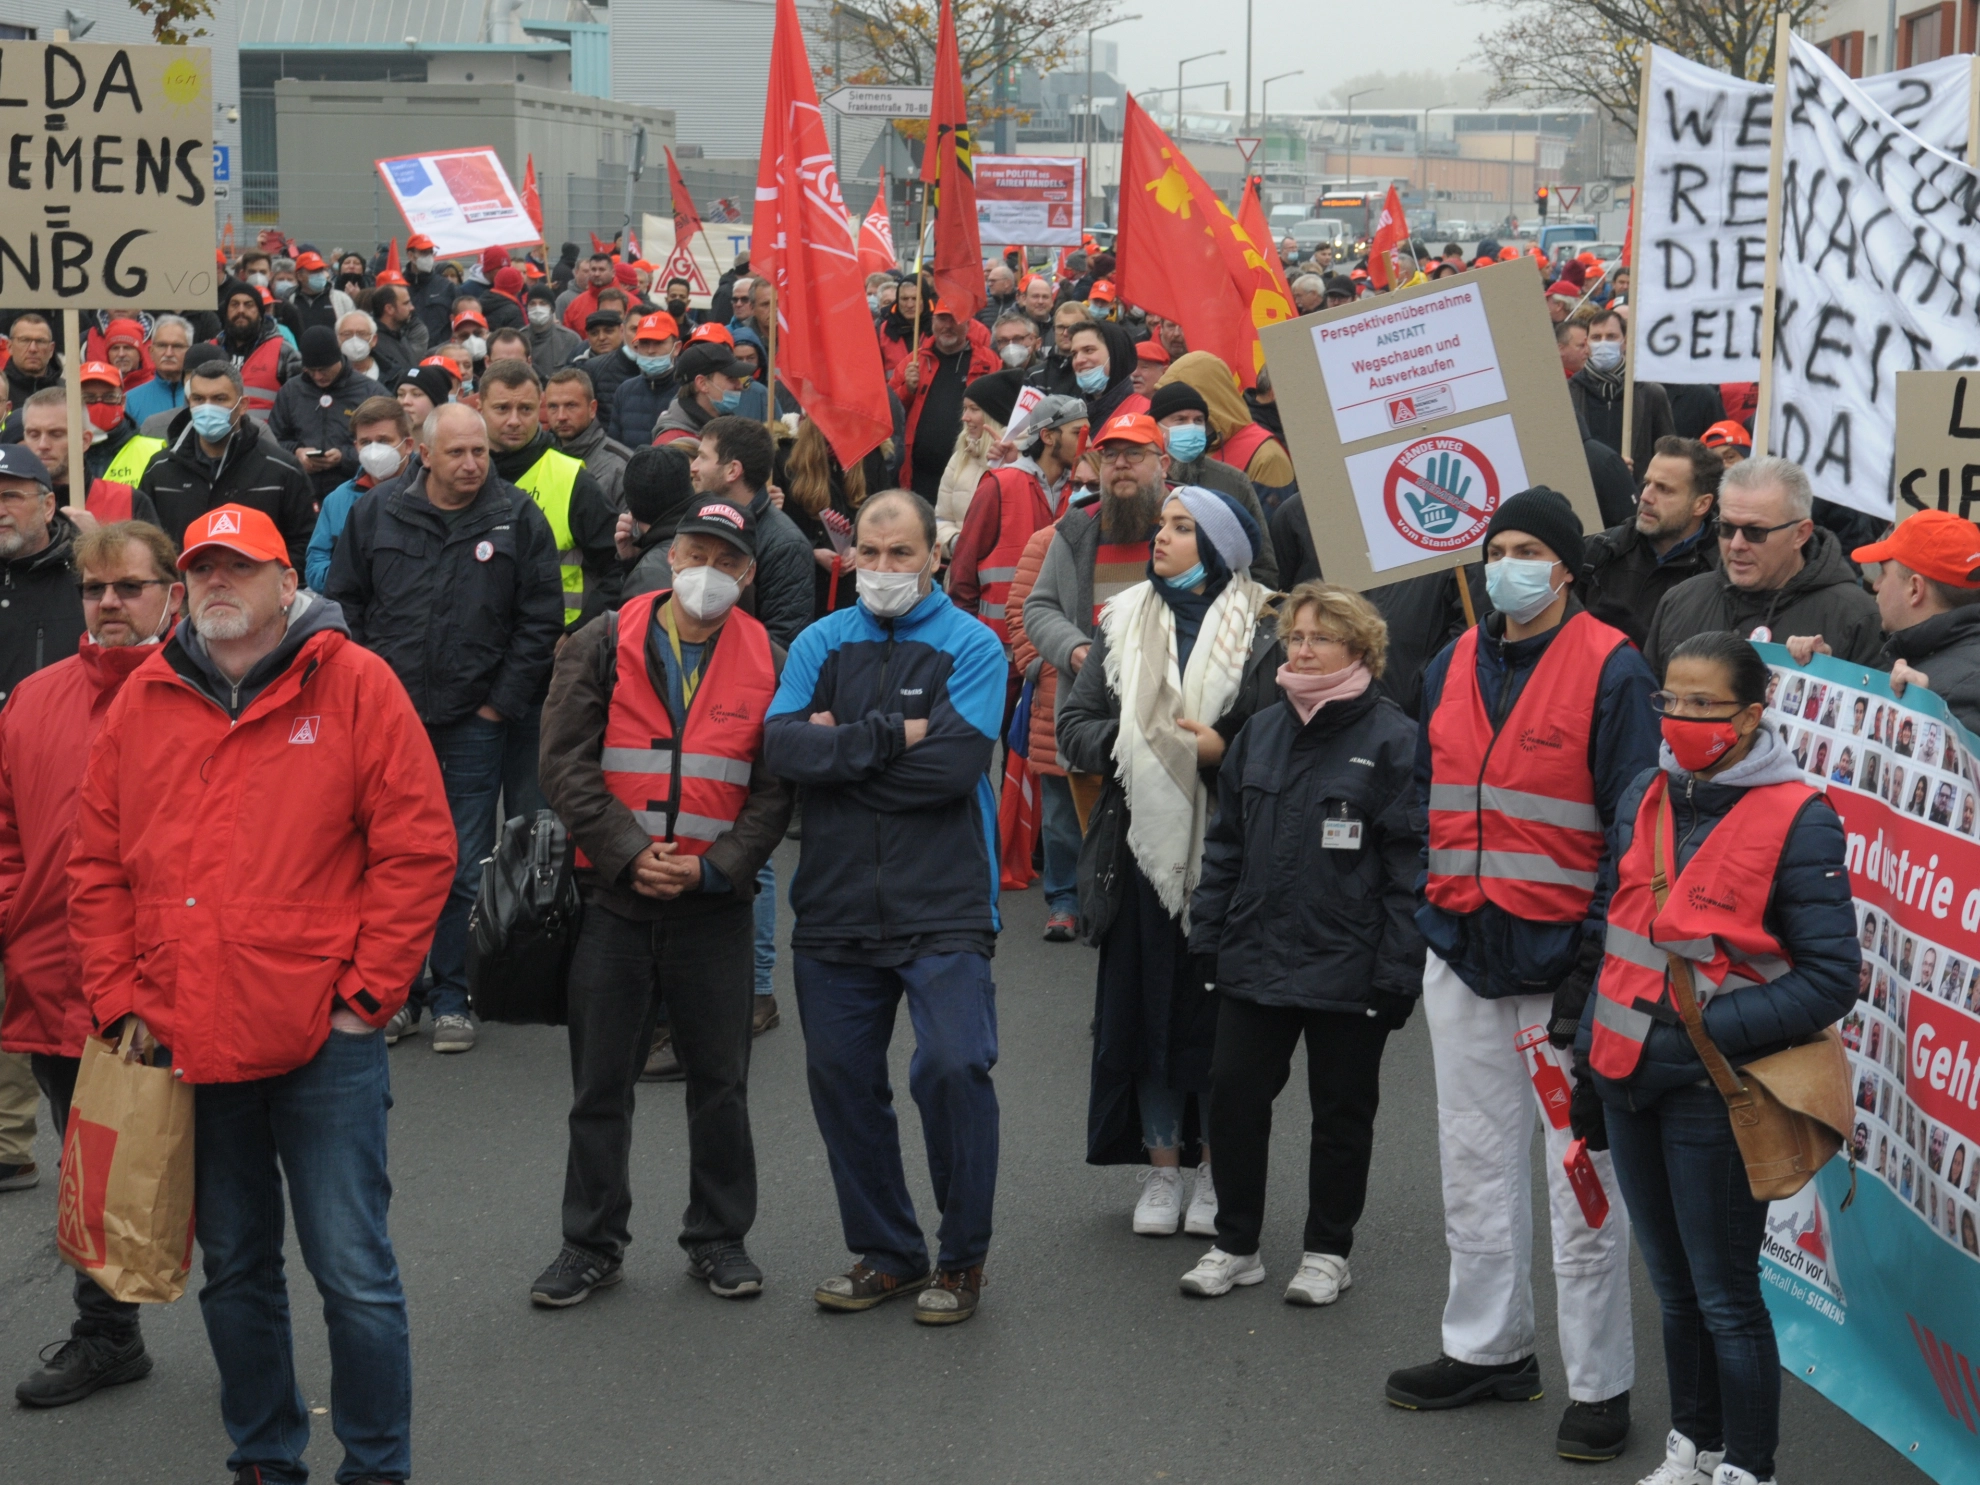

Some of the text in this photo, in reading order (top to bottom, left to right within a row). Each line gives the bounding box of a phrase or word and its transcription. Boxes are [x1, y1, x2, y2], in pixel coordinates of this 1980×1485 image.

[848, 101, 928, 113] Frankenstraße 70-80
[849, 91, 892, 101] Siemens
[996, 178, 1066, 189] FAIREN WANDELS.
[1006, 169, 1038, 179] POLITIK
[1320, 292, 1472, 342] Perspektivenübernahme
[1376, 323, 1426, 347] ANSTATT
[1352, 334, 1460, 374] Wegschauen und
[1369, 357, 1455, 390] Ausverkaufen
[1398, 440, 1464, 467] HÄNDE WEG
[1415, 477, 1470, 512] SIEMENS
[1396, 519, 1418, 541] vom
[1420, 533, 1471, 548] Standort
[1470, 516, 1491, 536] Nbg
[1841, 817, 1954, 919] ndustrie
[1762, 1231, 1823, 1281] Mensch vor
[1761, 1265, 1791, 1292] Metall
[1790, 1281, 1807, 1301] bei
[1806, 1291, 1846, 1326] SIEMENS
